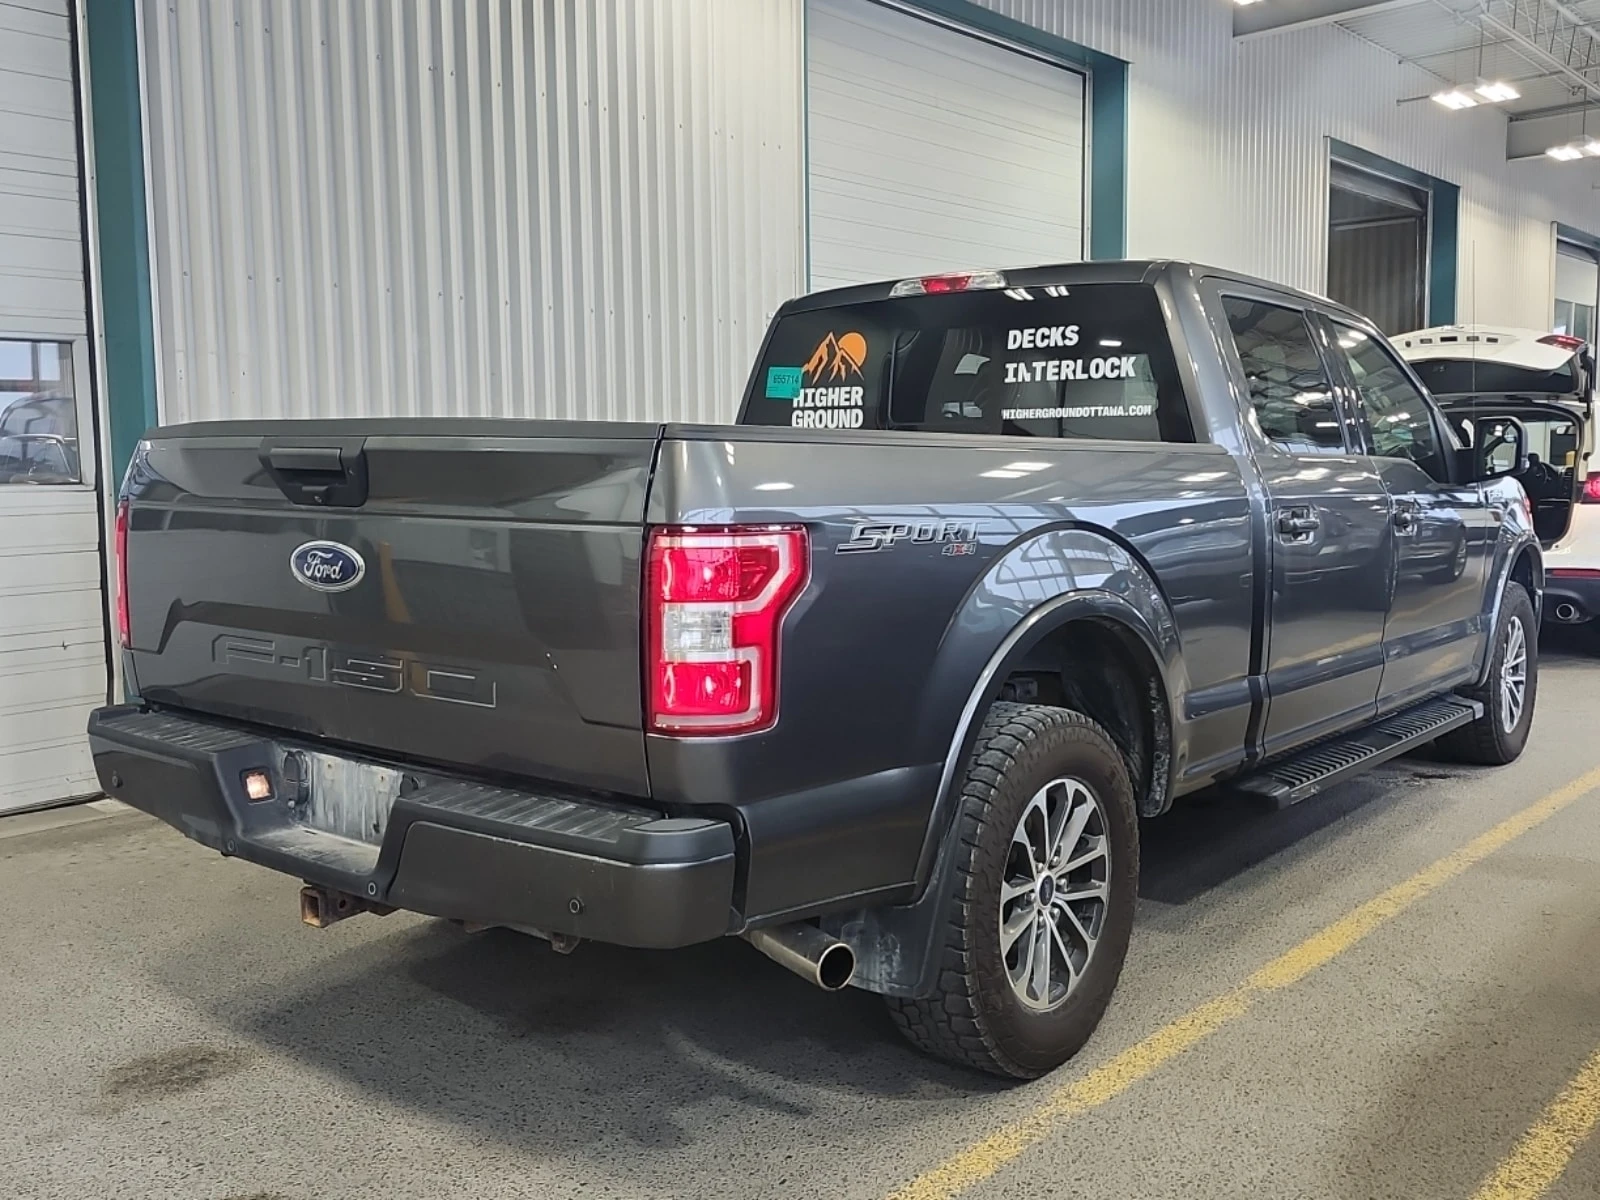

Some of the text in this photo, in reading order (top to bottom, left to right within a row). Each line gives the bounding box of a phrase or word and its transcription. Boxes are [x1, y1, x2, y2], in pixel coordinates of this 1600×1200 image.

[1007, 325, 1079, 349] DECKS
[1004, 356, 1136, 383] INTERLOCK
[792, 386, 864, 408] HIGHER
[791, 408, 864, 429] GROUND
[1002, 405, 1151, 420] HIGHERGROUNDOTTAWA.COM
[835, 521, 988, 555] SPORT
[303, 550, 343, 580] Ford
[212, 633, 496, 708] F-150
